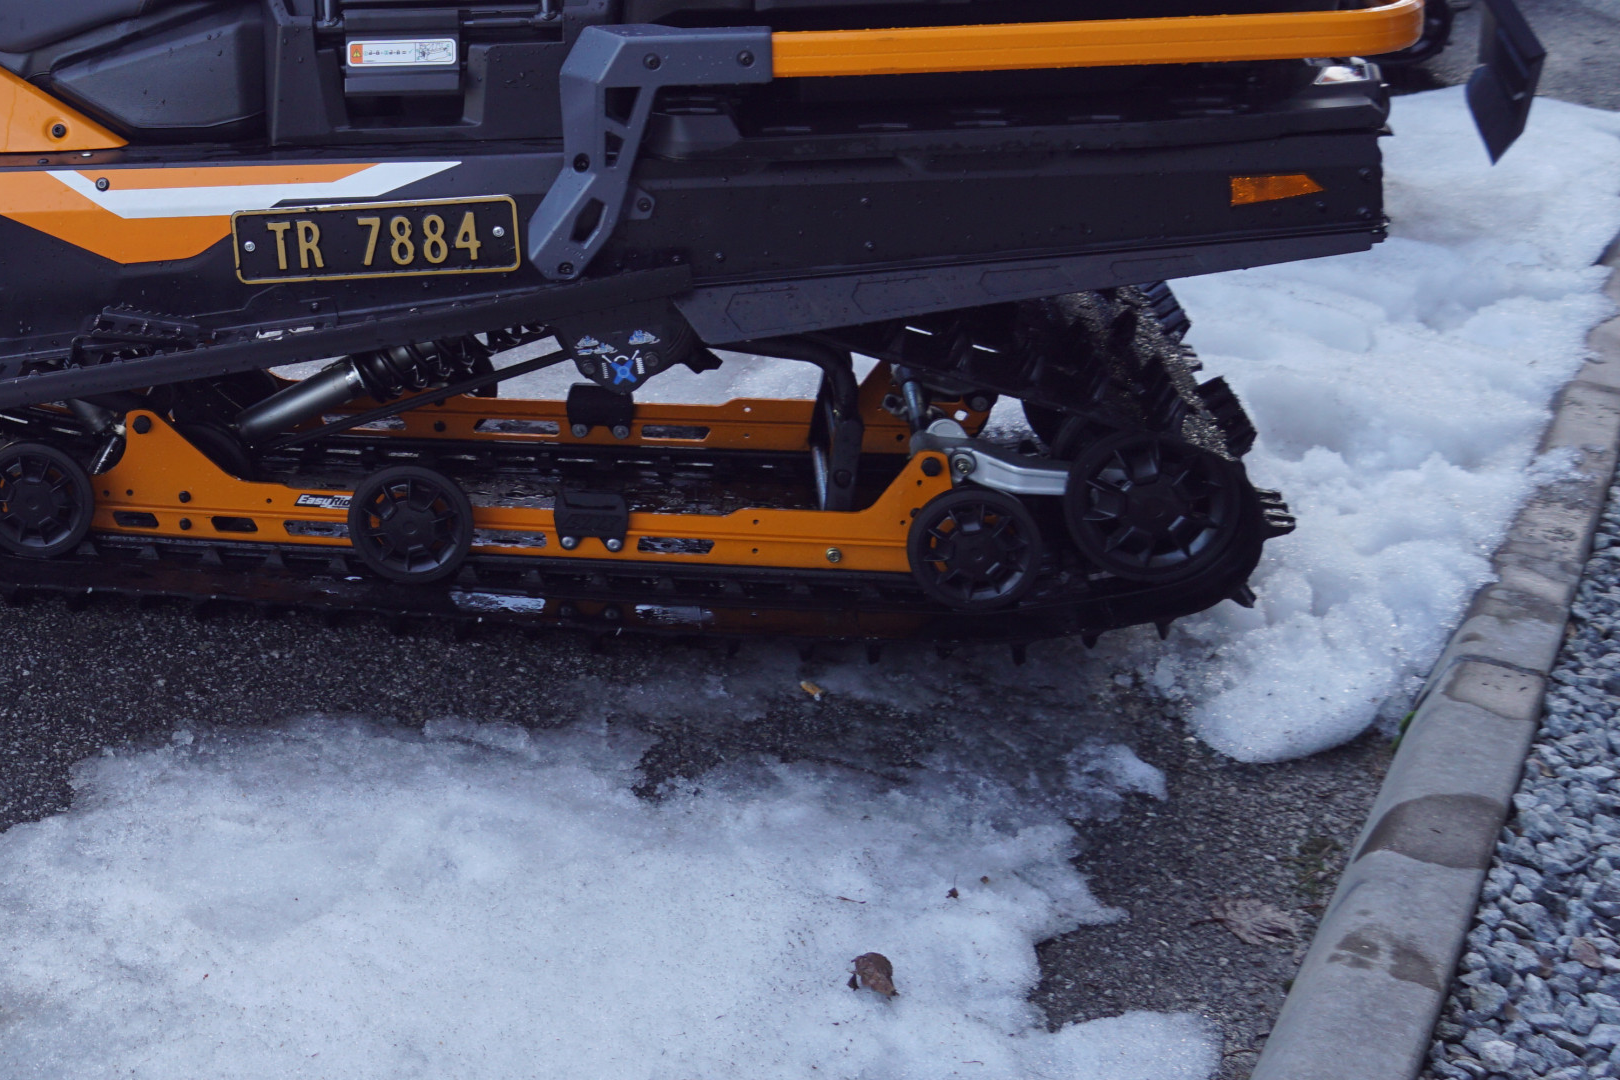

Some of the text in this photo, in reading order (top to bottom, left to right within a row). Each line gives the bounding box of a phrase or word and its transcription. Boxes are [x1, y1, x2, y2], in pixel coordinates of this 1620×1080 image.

[267, 211, 482, 270] TR 7884
[295, 494, 351, 509] EasyRid
